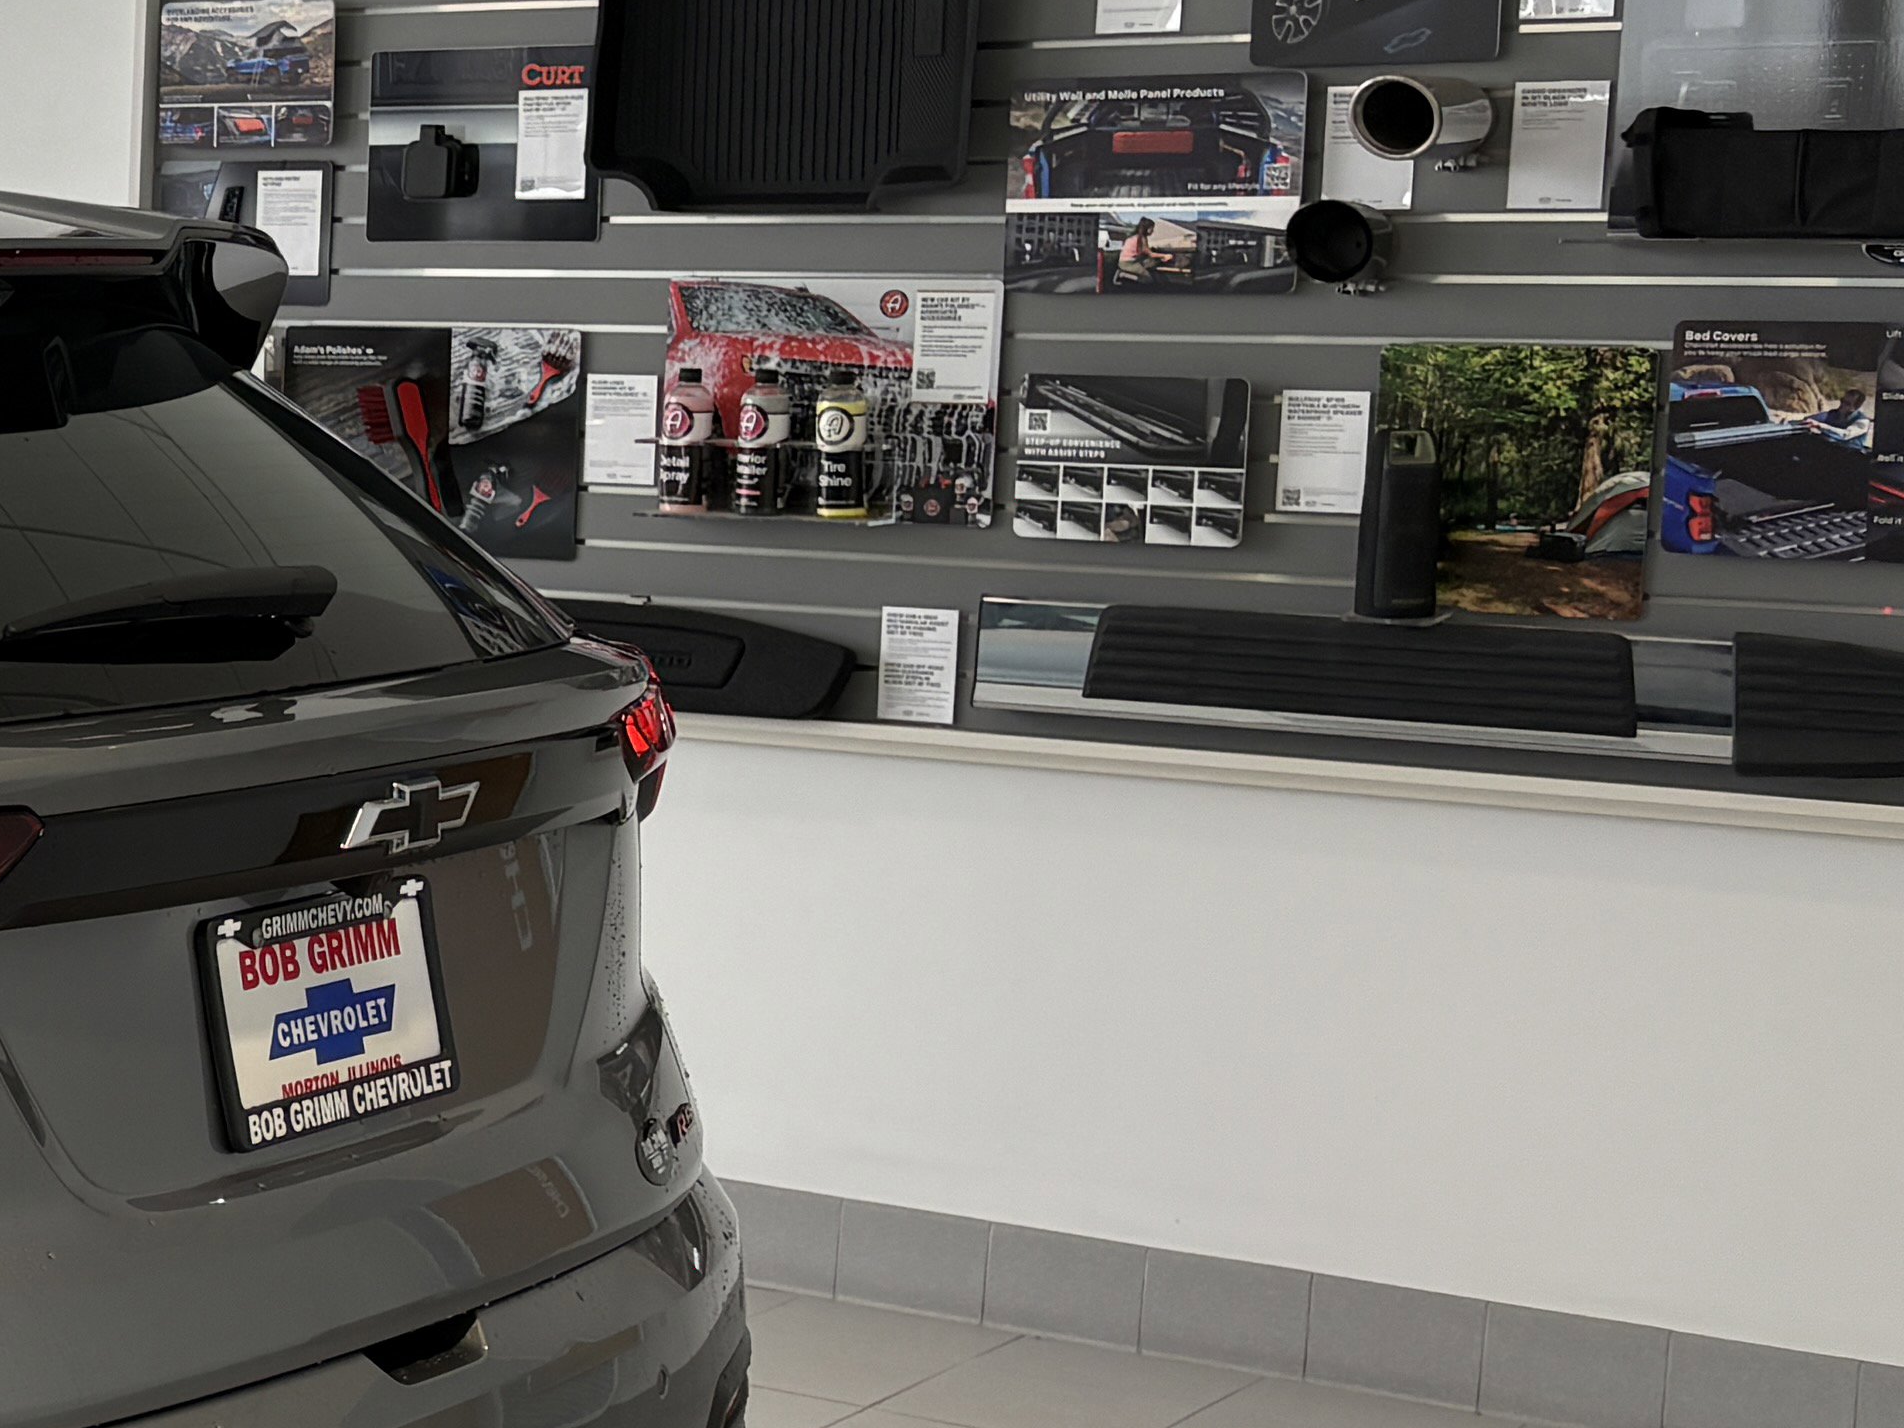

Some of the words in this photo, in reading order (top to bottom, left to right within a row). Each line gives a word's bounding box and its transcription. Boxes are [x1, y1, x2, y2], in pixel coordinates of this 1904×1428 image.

[521, 63, 585, 86] CURT
[1024, 92, 1057, 104] Utility
[1059, 91, 1082, 101] Wall
[1084, 90, 1106, 101] and
[1107, 90, 1138, 100] Molle
[1140, 89, 1170, 99] Panel
[1173, 88, 1225, 98] Products
[1685, 330, 1710, 341] Bed
[1713, 330, 1758, 341] Covers
[1886, 330, 1902, 338] Lift
[822, 459, 846, 473] Tire
[818, 474, 852, 488] Shine
[261, 893, 384, 939] GRIMMCHEVY.COM
[239, 941, 301, 991] BOB
[307, 917, 402, 974] GRIMM
[276, 997, 389, 1048] CHEVROLET
[280, 1070, 340, 1100] MORTON
[347, 1054, 403, 1083] ILLINOIS
[247, 1113, 287, 1145] BOB
[290, 1088, 350, 1133] GRIMM
[352, 1060, 453, 1117] CHEVROLET
